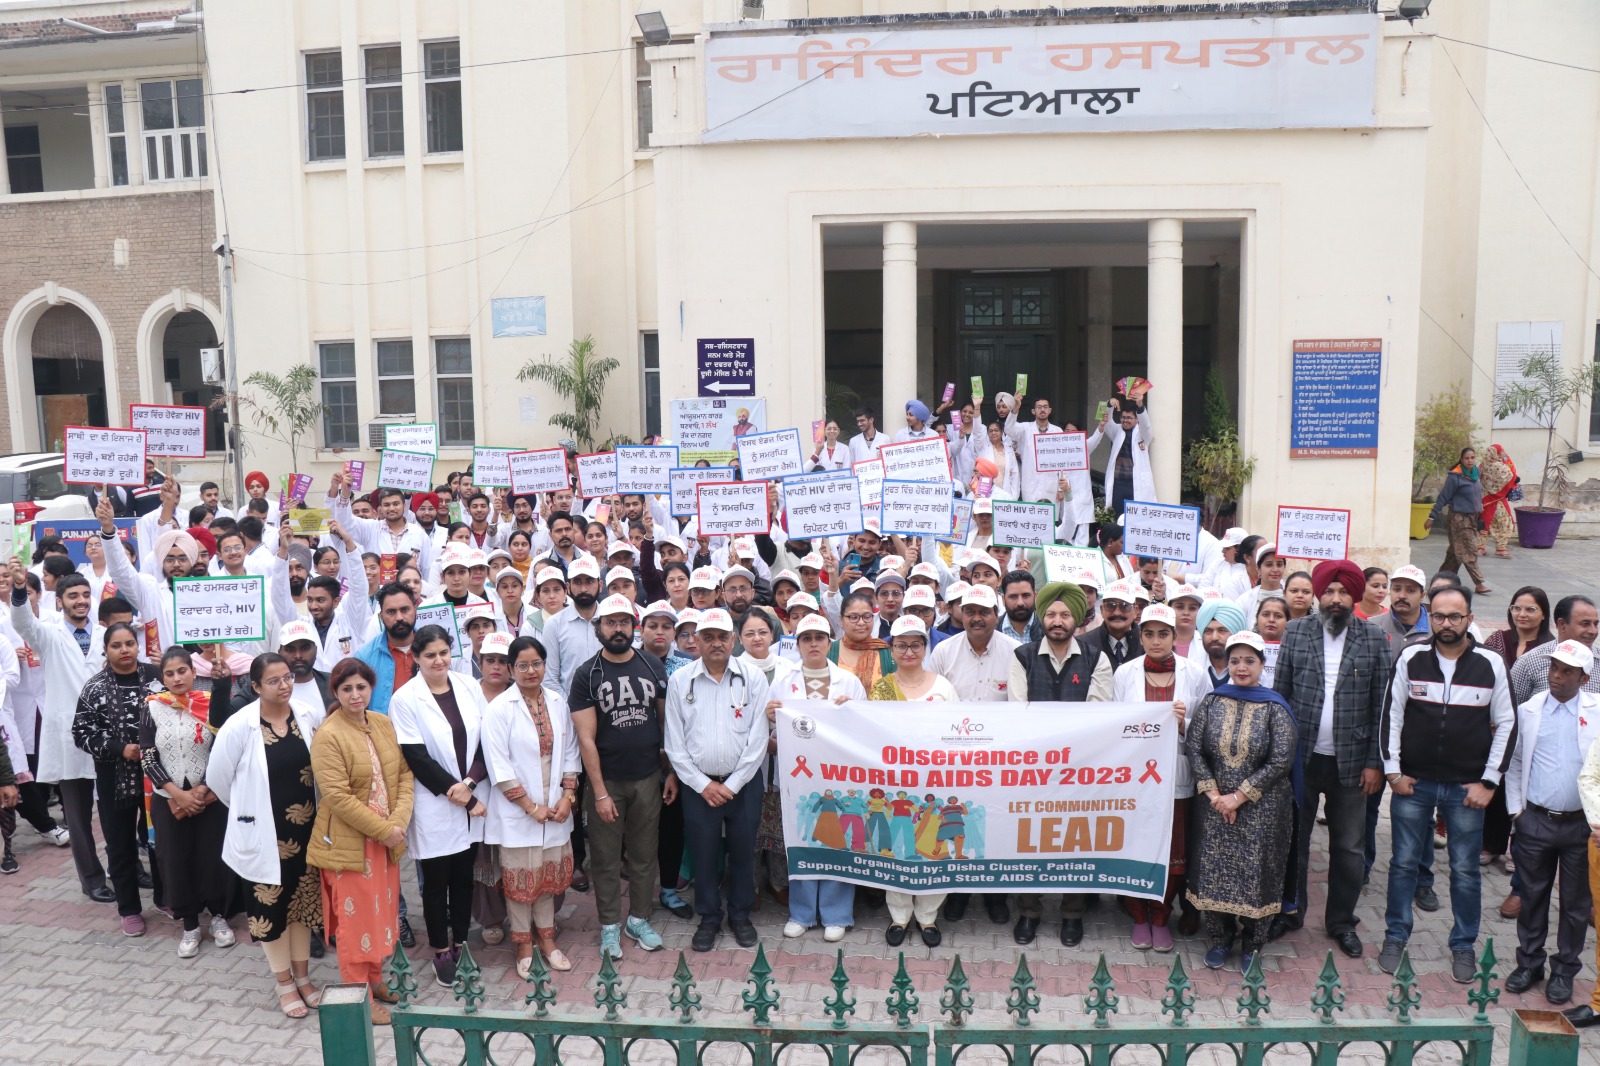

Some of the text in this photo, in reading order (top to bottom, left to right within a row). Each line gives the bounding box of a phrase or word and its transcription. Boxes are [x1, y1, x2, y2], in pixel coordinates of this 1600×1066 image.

[711, 34, 1369, 83] ਰਾਜਿੰਦਰਾ ਹਸਪਤਾਲ
[927, 81, 1140, 117] ਪਟਿਆਲਾ
[701, 370, 711, 379] ਦੂਜੀ
[68, 432, 84, 440] ਸਾਥੀ
[101, 433, 108, 441] ਵੀ
[112, 433, 133, 442] ਇਲਾਜ
[136, 433, 142, 443] ਹੈ
[102, 453, 115, 461] ਬਣੀ
[118, 453, 138, 462] ਰਹੇਗੀ
[72, 469, 89, 477] ਗੁਪਤ
[120, 470, 133, 480] ਦੂਰੀ
[742, 486, 763, 494] ਦਿਵਸ
[786, 486, 806, 496] ਆਪਣੀ
[810, 486, 825, 494] HIV
[828, 483, 835, 492] ਦੀ
[902, 485, 913, 493] ਵਿੱਚ
[722, 502, 754, 511] ਸਮਰਪਿਤ
[819, 503, 831, 512] ਅਤੇ
[833, 502, 851, 513] ਗੁਪਤ
[893, 501, 911, 510] ਇਲਾਜ
[914, 504, 930, 513] ਗੁਪਤ
[932, 504, 948, 512] ਰਹੇਗੀ
[1127, 506, 1138, 514] HIV
[707, 521, 742, 531] ਜਾਗਰੂਕਤਾ
[895, 519, 913, 529] ਤੁਹਾਡੀ
[1174, 532, 1190, 540] ICTC
[177, 583, 201, 592] ਆਪਣੇ
[242, 580, 258, 593] ਪ੍ਰਤੀ
[236, 604, 255, 613] HIV
[435, 608, 449, 619] ਪ੍ਰਤੀ
[185, 628, 200, 637] ਅਤੇ
[203, 628, 220, 636] STI
[599, 676, 655, 713] GAP
[611, 707, 646, 720] New York
[882, 746, 1071, 765] Observance of
[820, 762, 1132, 788] WORLD AIDS DAY 2023
[1008, 798, 1136, 813] LET COMMUNITIES
[1017, 816, 1124, 853] LEAD
[854, 856, 1095, 875] Organised by: Disha Cluster, Patiala
[797, 861, 1154, 889] Supported by: Punjab State AIDS Control Society
